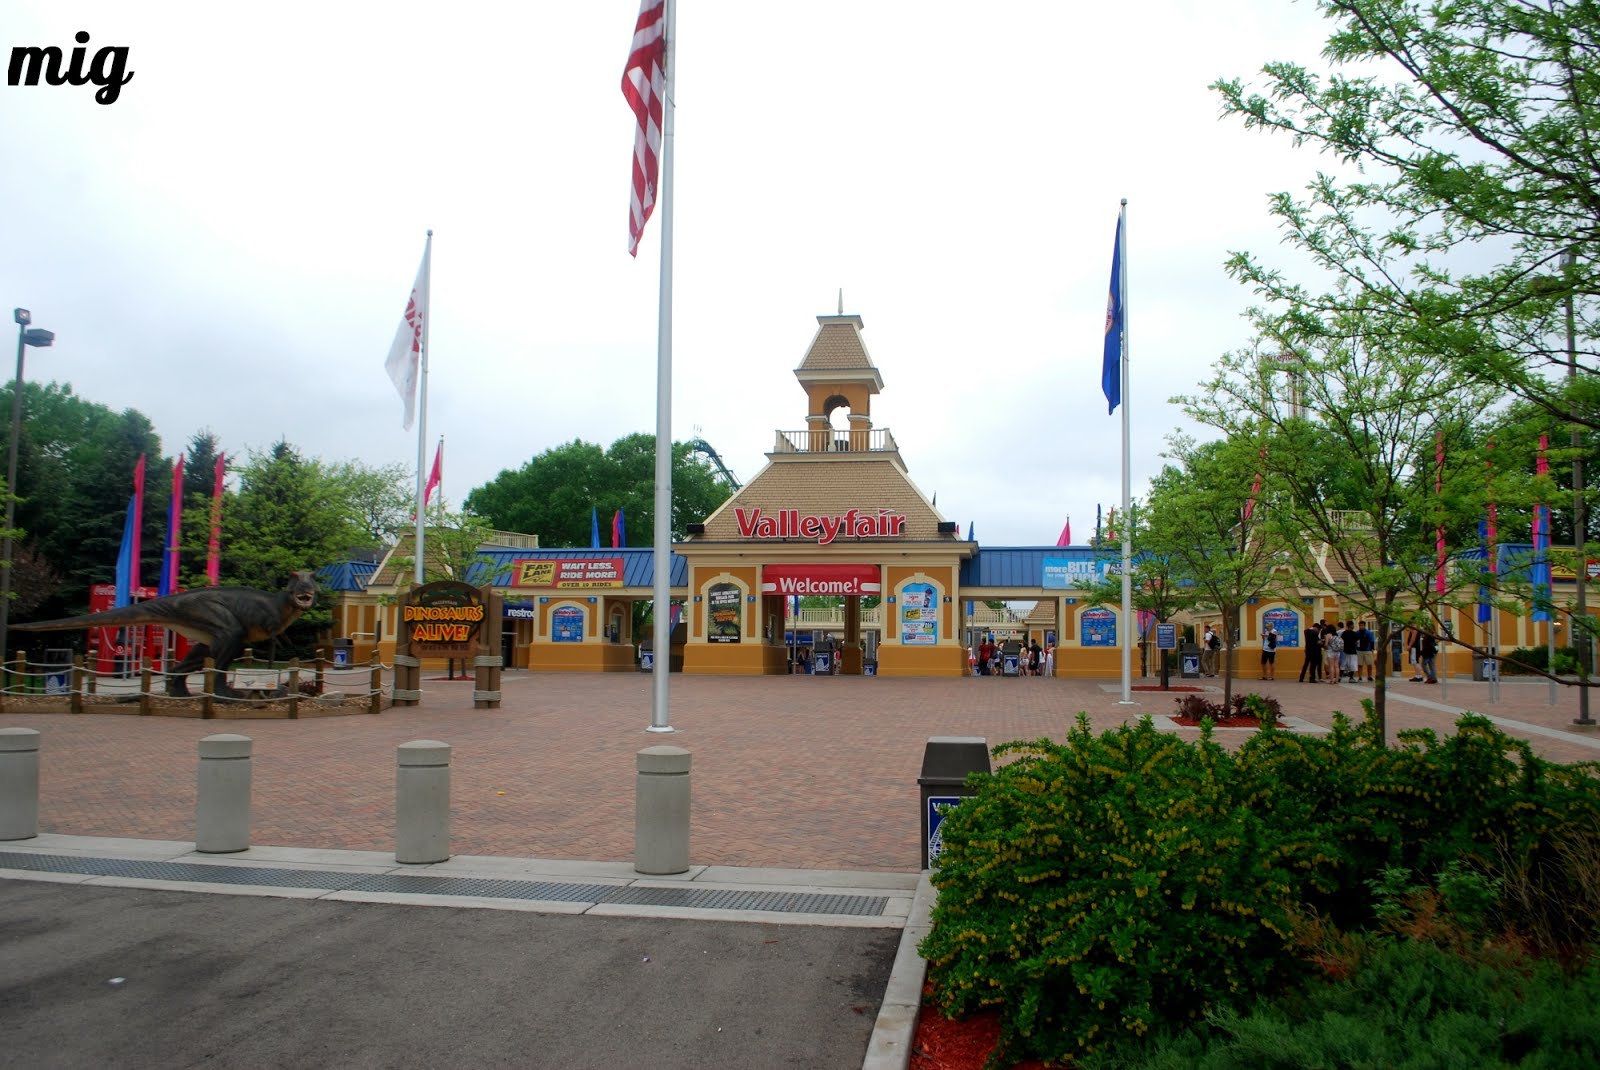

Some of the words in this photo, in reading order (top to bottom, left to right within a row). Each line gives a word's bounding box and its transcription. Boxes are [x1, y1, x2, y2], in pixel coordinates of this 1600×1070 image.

[734, 507, 906, 544] Valleyfair
[525, 564, 553, 572] FAST
[561, 562, 585, 570] WAIT
[588, 562, 614, 570] LESS.
[1067, 561, 1095, 573] BITE
[523, 569, 552, 580] LANE
[560, 571, 583, 579] RIDE
[586, 570, 617, 579] MORE!
[779, 577, 858, 593] Welcome!
[403, 604, 484, 622] DINOSAURS
[412, 623, 470, 642] ALIVE!
